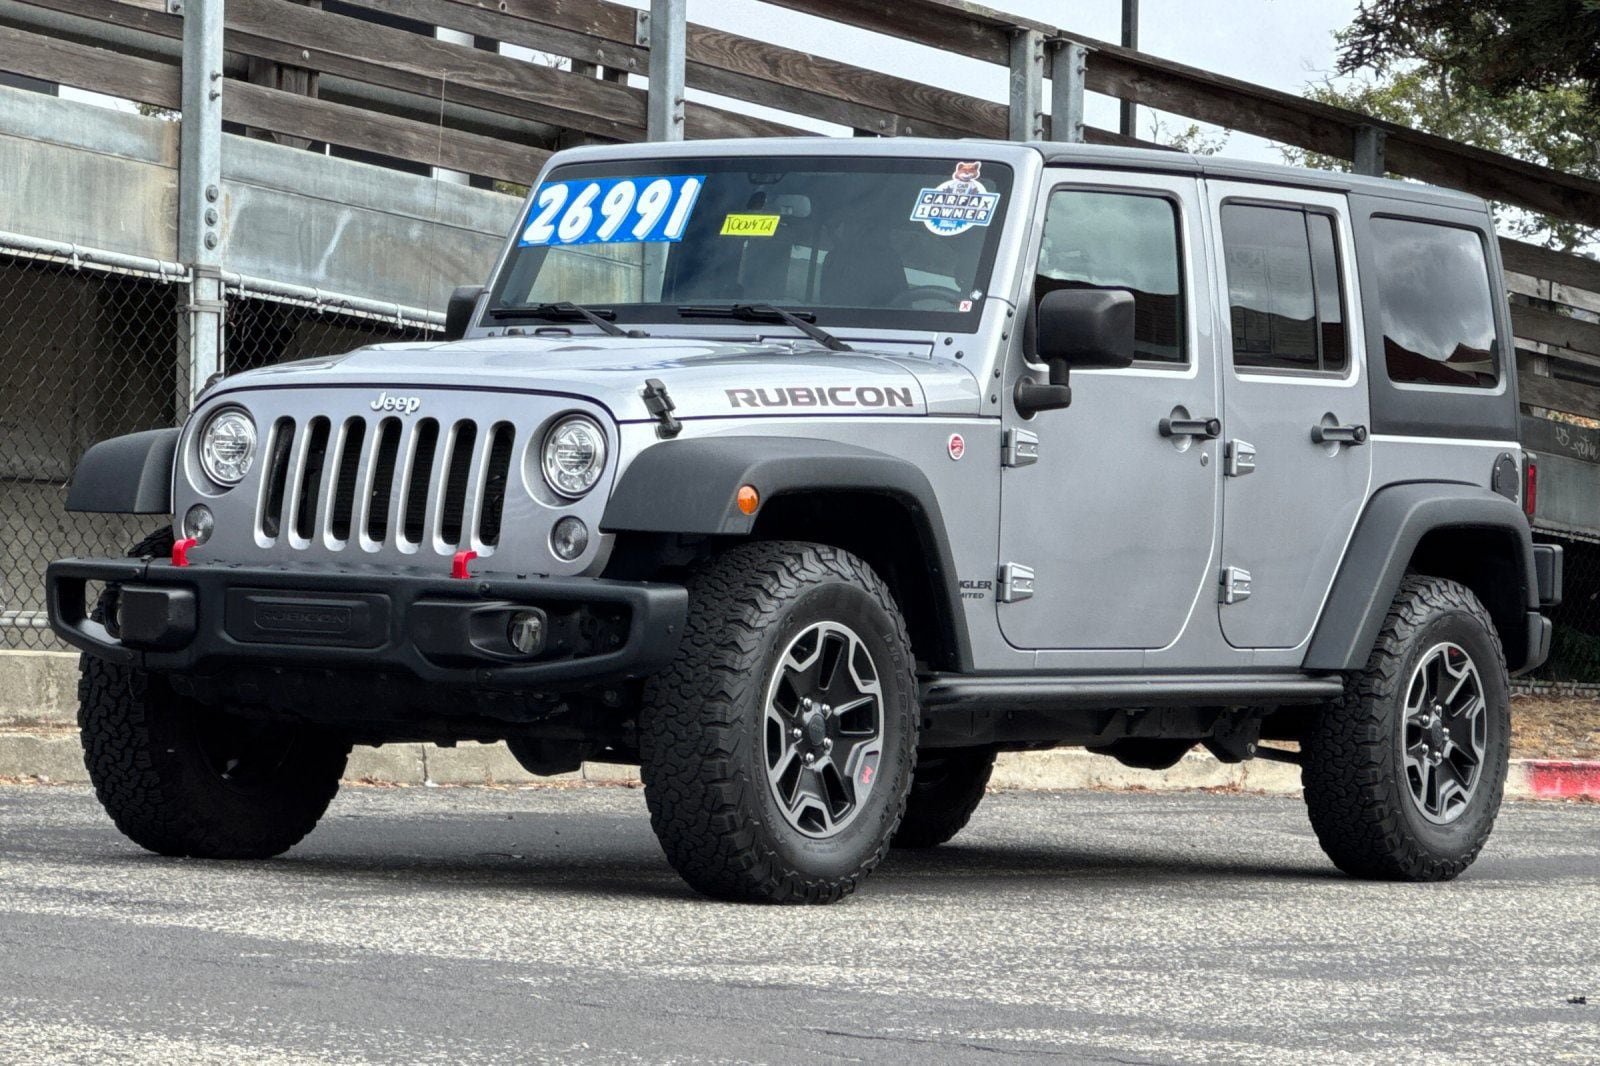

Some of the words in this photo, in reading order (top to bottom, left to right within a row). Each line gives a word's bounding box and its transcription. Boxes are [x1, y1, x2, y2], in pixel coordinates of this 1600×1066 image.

[922, 193, 991, 209] CARFAX
[523, 178, 701, 244] 26991
[930, 206, 987, 220] OWNER
[370, 391, 420, 416] Jeep
[724, 386, 914, 408] RUBICON
[260, 610, 346, 624] RUBICON
